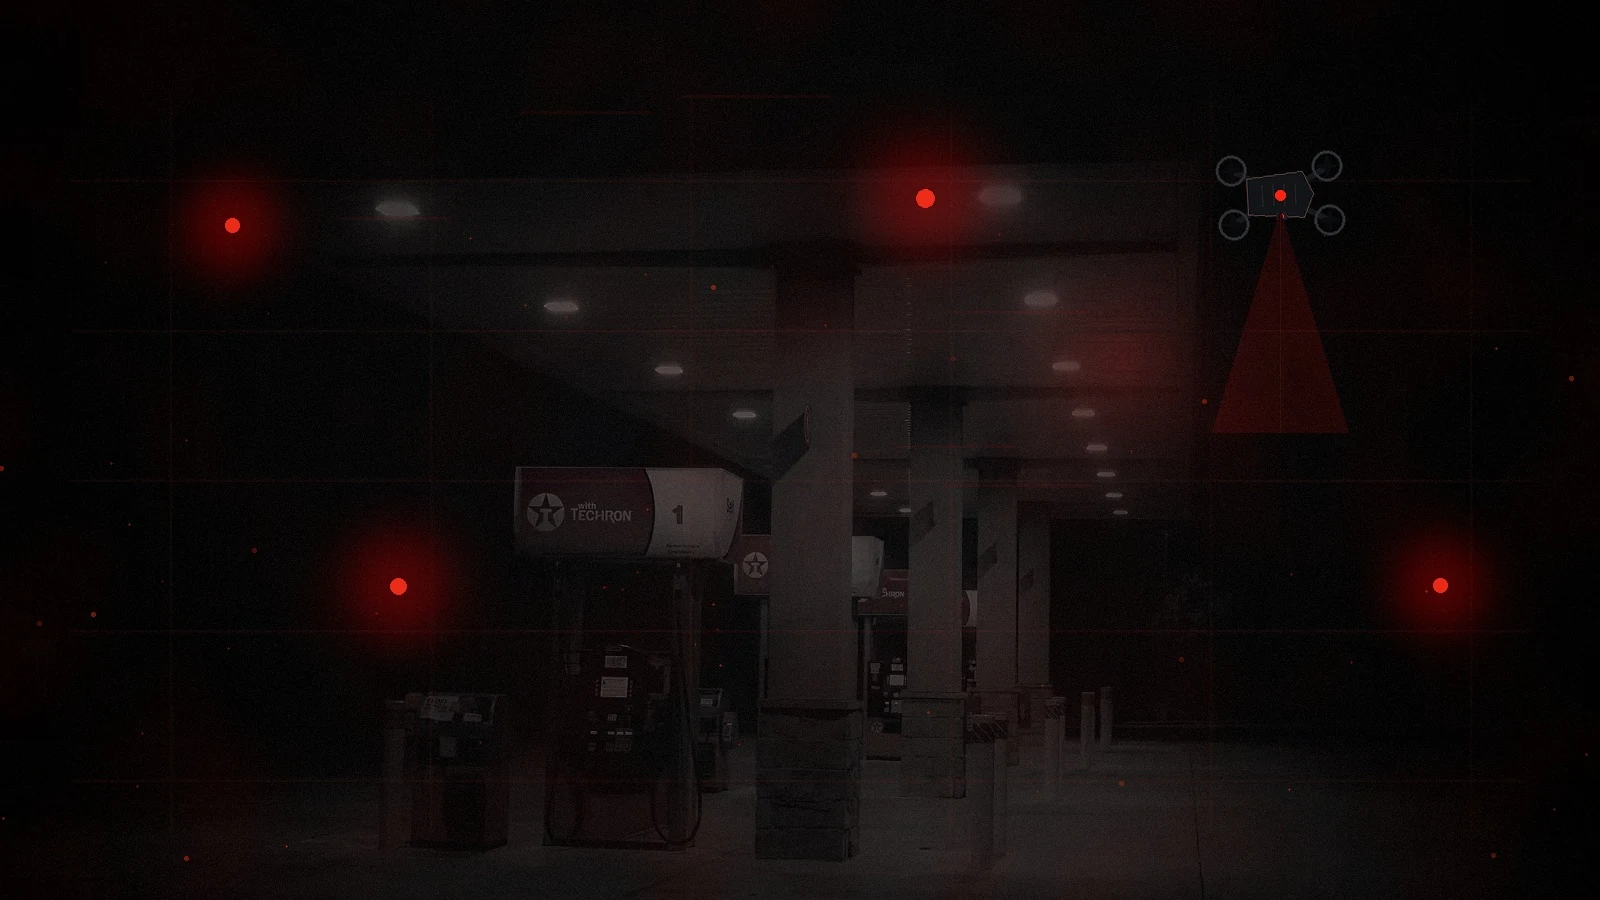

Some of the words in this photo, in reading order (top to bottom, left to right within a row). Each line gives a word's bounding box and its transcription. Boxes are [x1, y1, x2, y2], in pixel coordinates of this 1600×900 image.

[578, 501, 597, 510] with
[570, 507, 632, 524] TECHRON
[672, 505, 684, 525] 1
